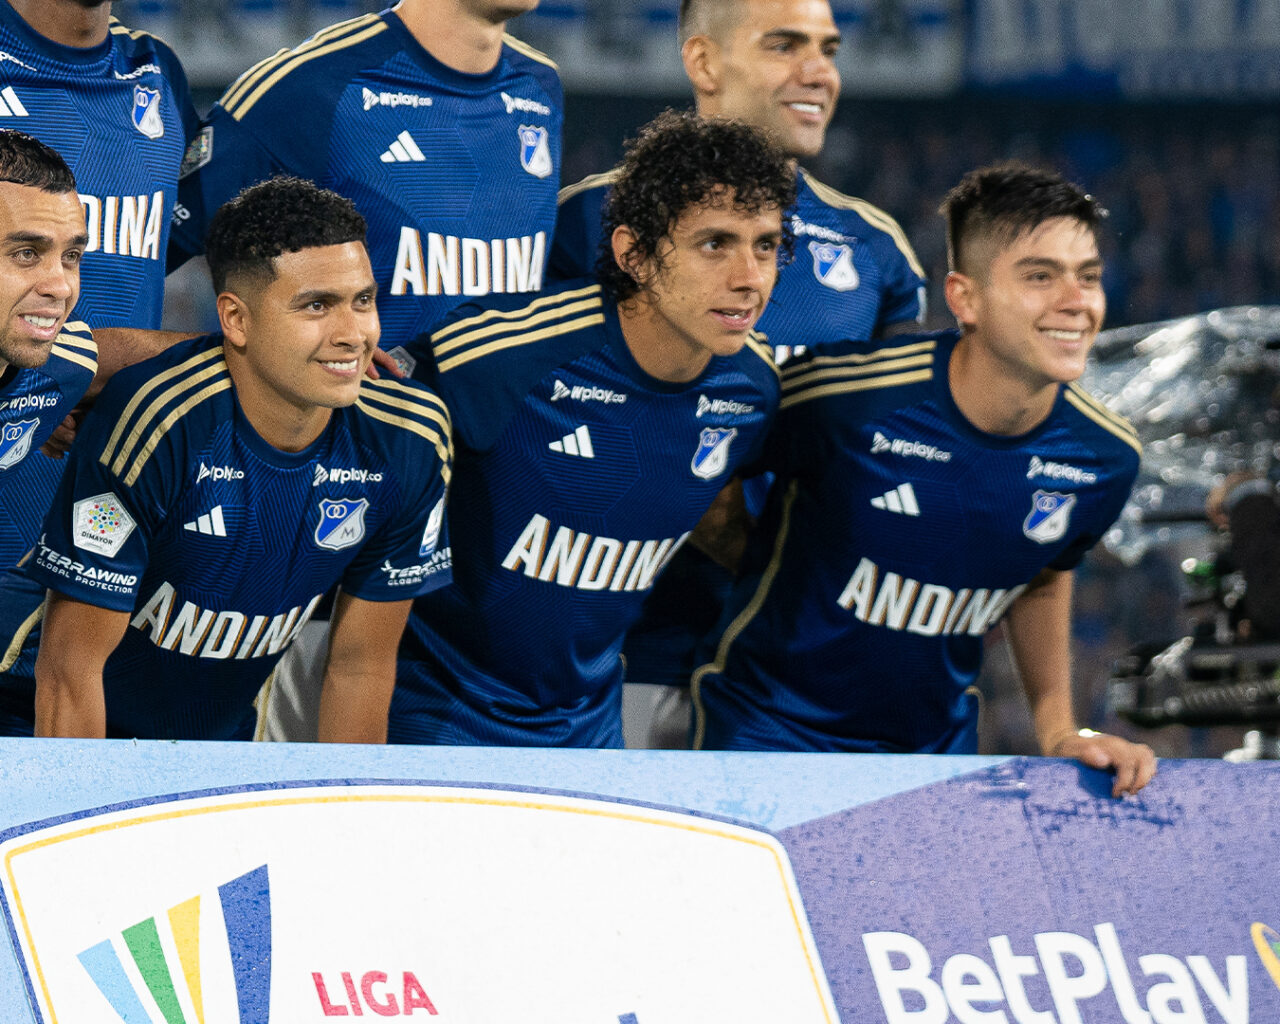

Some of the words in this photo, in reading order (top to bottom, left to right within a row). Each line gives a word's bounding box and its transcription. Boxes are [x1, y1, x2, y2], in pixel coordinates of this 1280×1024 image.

[79, 190, 164, 261] DINA
[390, 226, 546, 297] ANDINA
[81, 531, 113, 546] DIMAYOR
[36, 558, 70, 578] GLOBAL
[75, 575, 133, 594] PROTECTION
[40, 546, 138, 586] TERRAWIND
[311, 969, 439, 1017] LIGA
[862, 922, 1250, 1024] BetPlay
